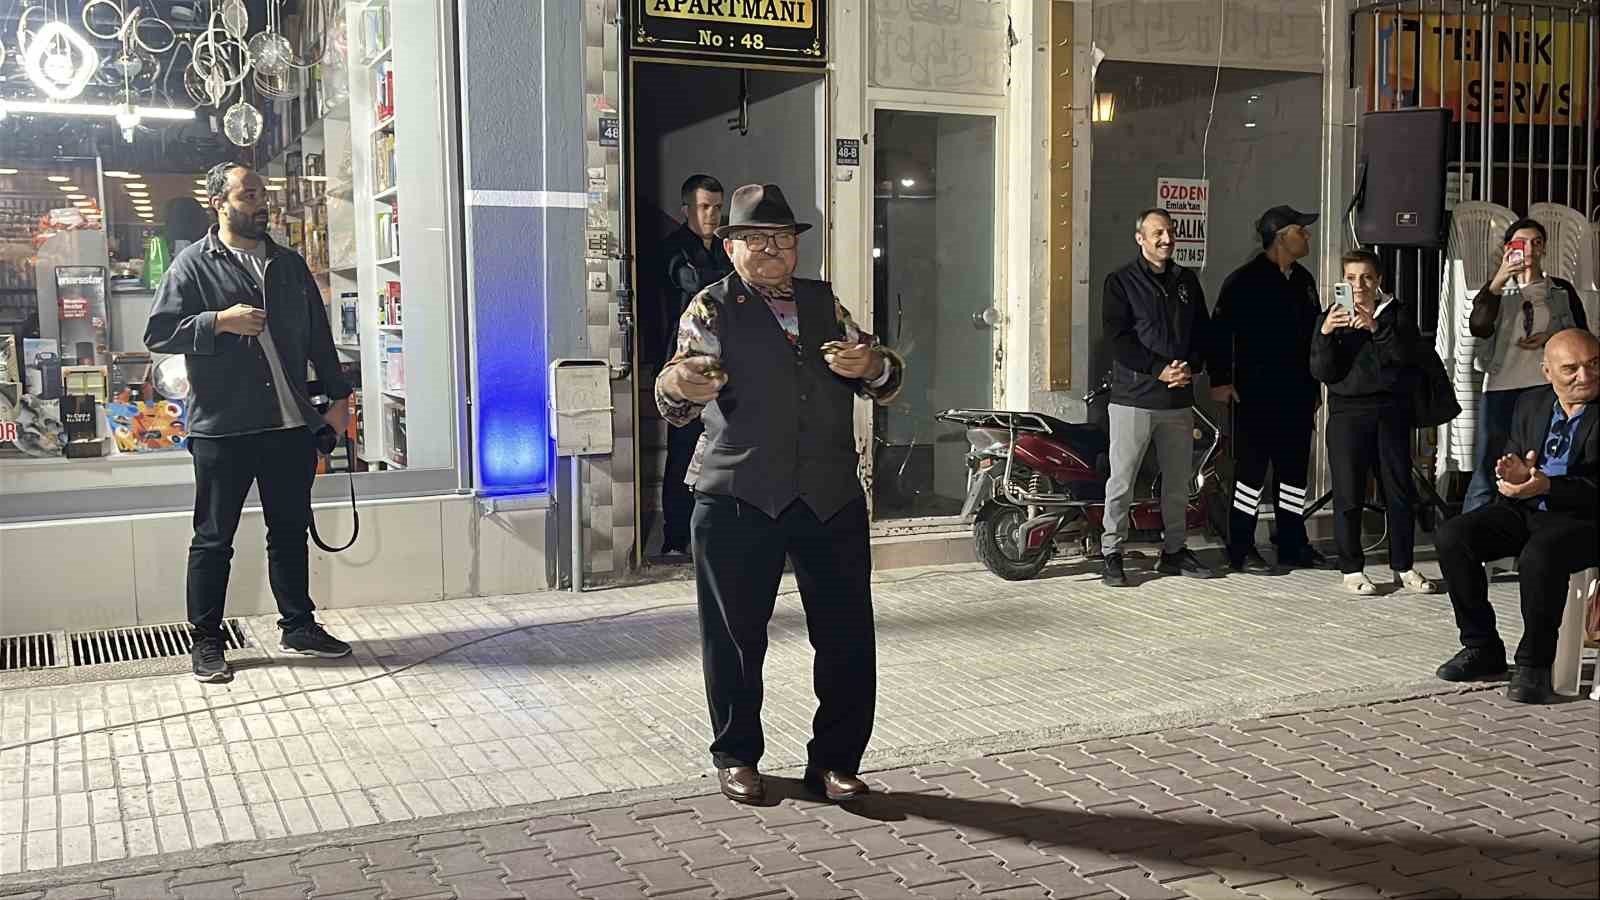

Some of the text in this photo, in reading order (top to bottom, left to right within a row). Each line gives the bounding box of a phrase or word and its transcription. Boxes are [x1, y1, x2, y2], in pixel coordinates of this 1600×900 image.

[654, 0, 805, 22] APARTMANI
[699, 30, 722, 46] No
[741, 33, 764, 49] 48
[1466, 79, 1570, 115] SERVS
[1160, 181, 1207, 201] ÖZDEN
[1172, 219, 1206, 238] RALIK
